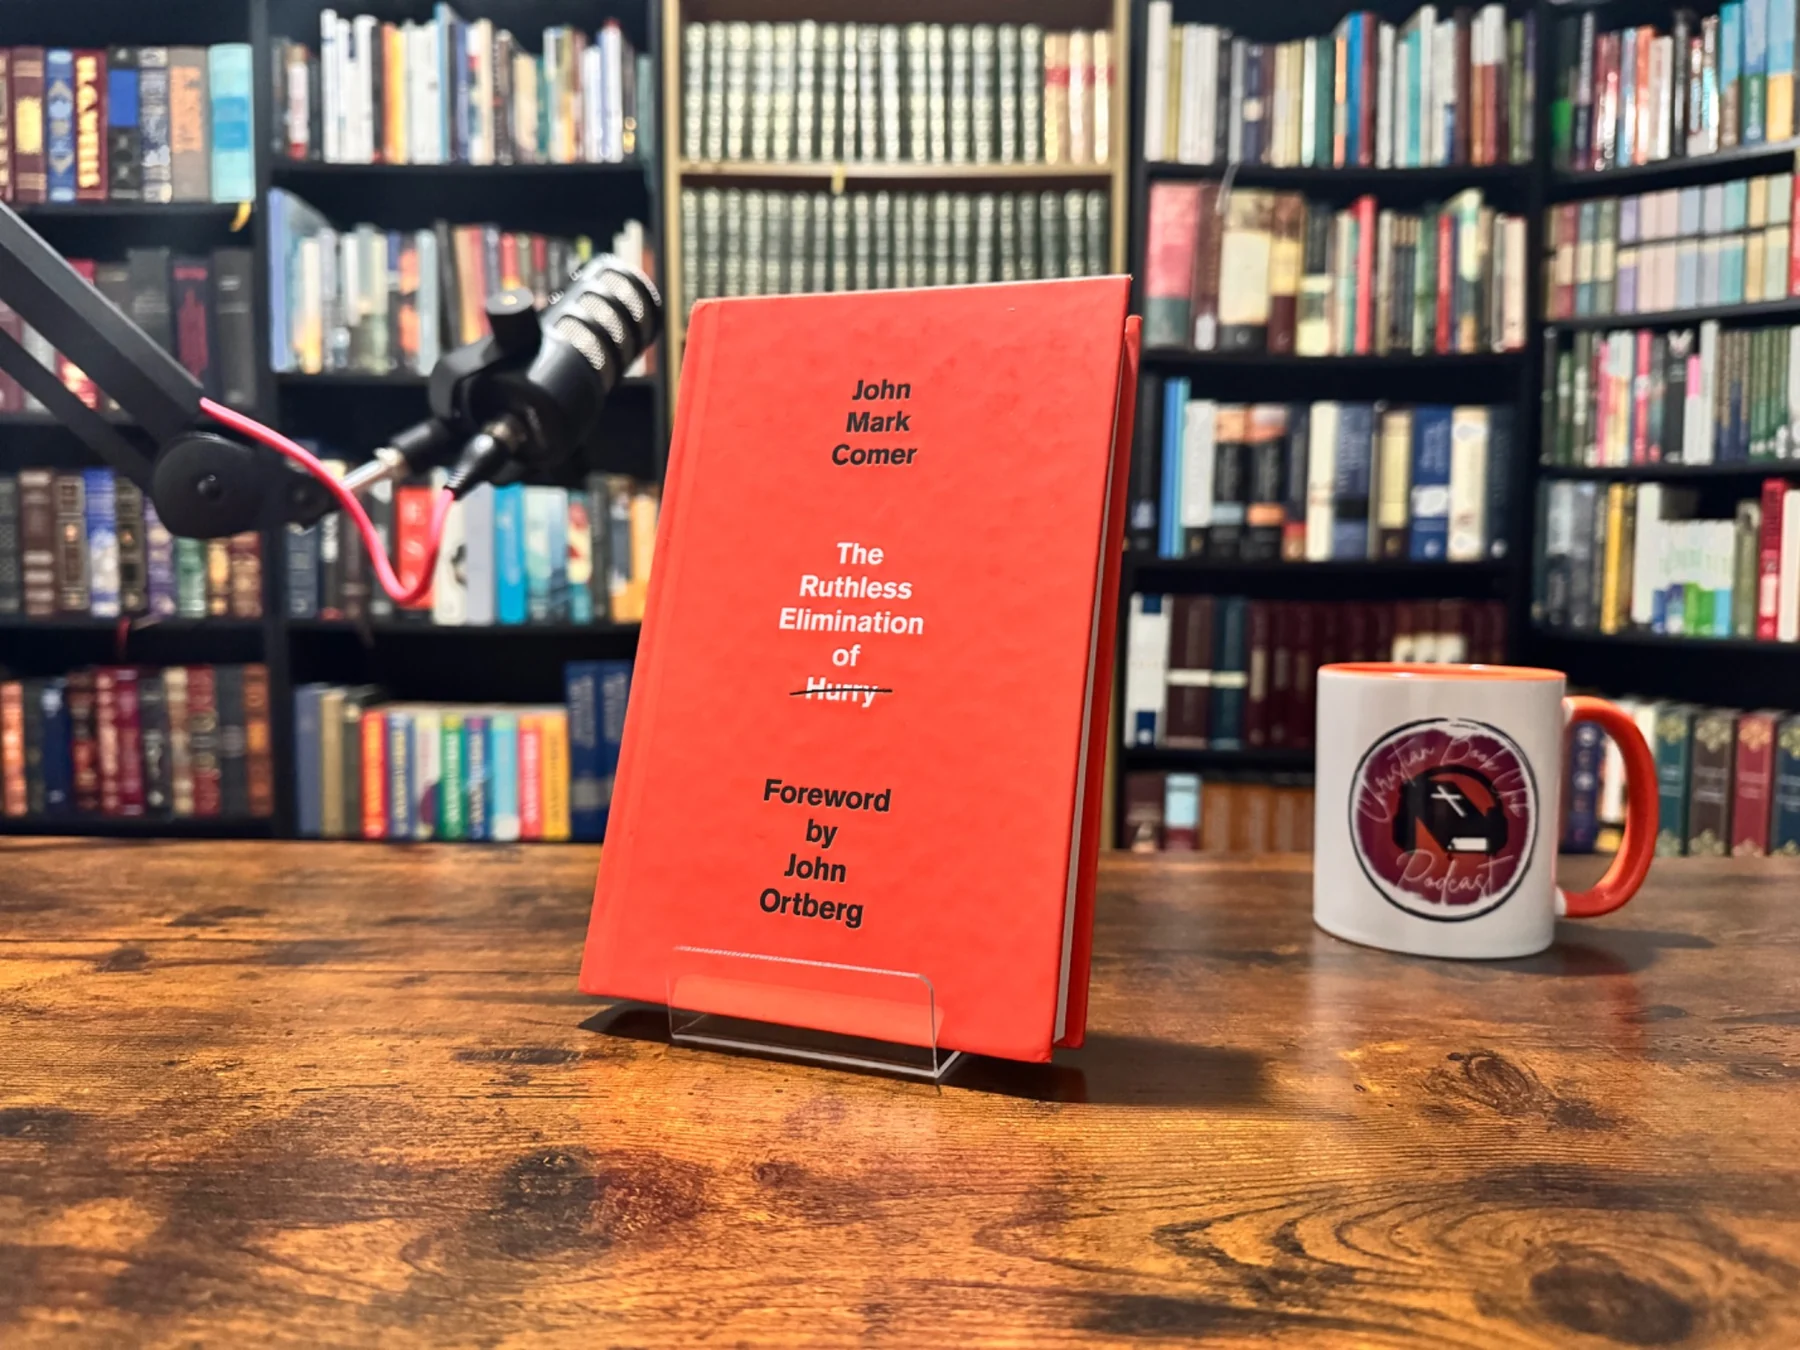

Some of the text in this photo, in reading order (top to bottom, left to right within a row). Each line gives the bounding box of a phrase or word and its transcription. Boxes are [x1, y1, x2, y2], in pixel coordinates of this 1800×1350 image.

[852, 379, 911, 401] John
[846, 411, 911, 433] Mark
[832, 443, 918, 466] Comer
[837, 542, 884, 565] The
[799, 574, 913, 600] Ruthless
[779, 607, 925, 635] Elimination
[832, 644, 861, 667] of
[804, 676, 878, 708] Hurry
[763, 778, 892, 813] Foreword
[805, 818, 839, 849] by
[784, 853, 847, 883] John
[1396, 848, 1515, 906] Podcast
[759, 887, 864, 929] Ortberg
